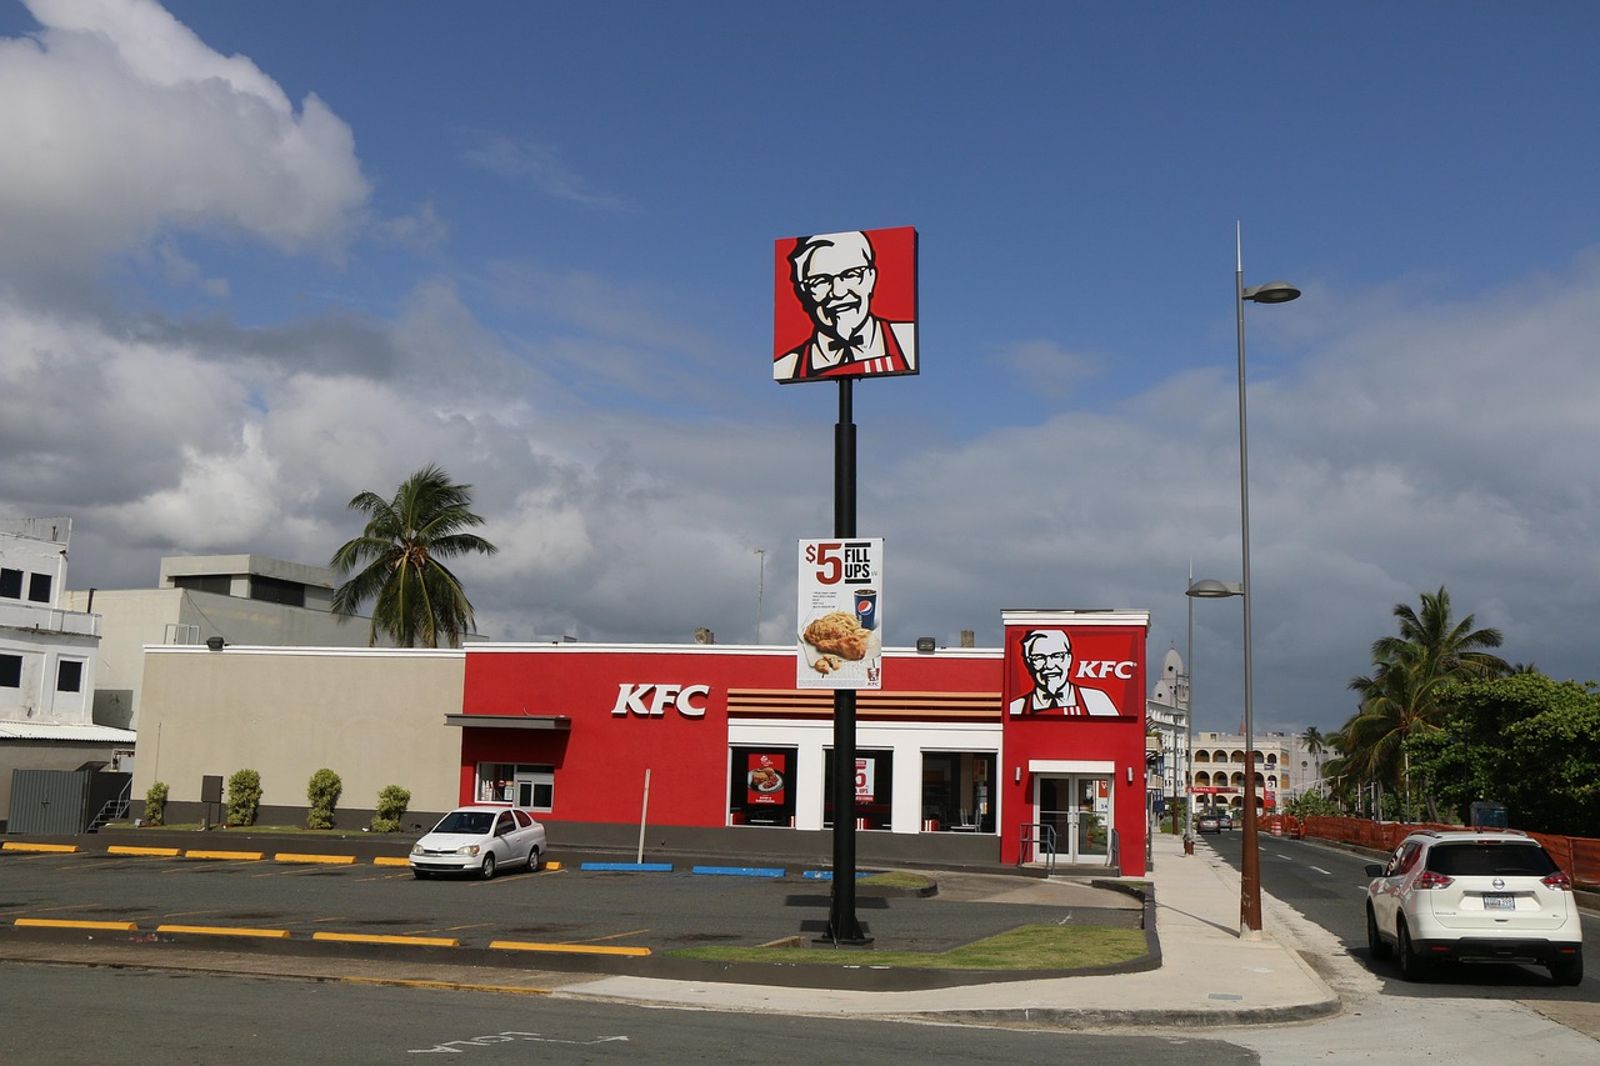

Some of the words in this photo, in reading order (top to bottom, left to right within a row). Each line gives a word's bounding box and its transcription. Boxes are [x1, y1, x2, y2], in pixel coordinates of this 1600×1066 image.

[806, 543, 842, 585] $5
[845, 548, 871, 563] FILL
[845, 564, 870, 578] UPS
[1075, 660, 1134, 680] KFC
[611, 683, 710, 716] KFC
